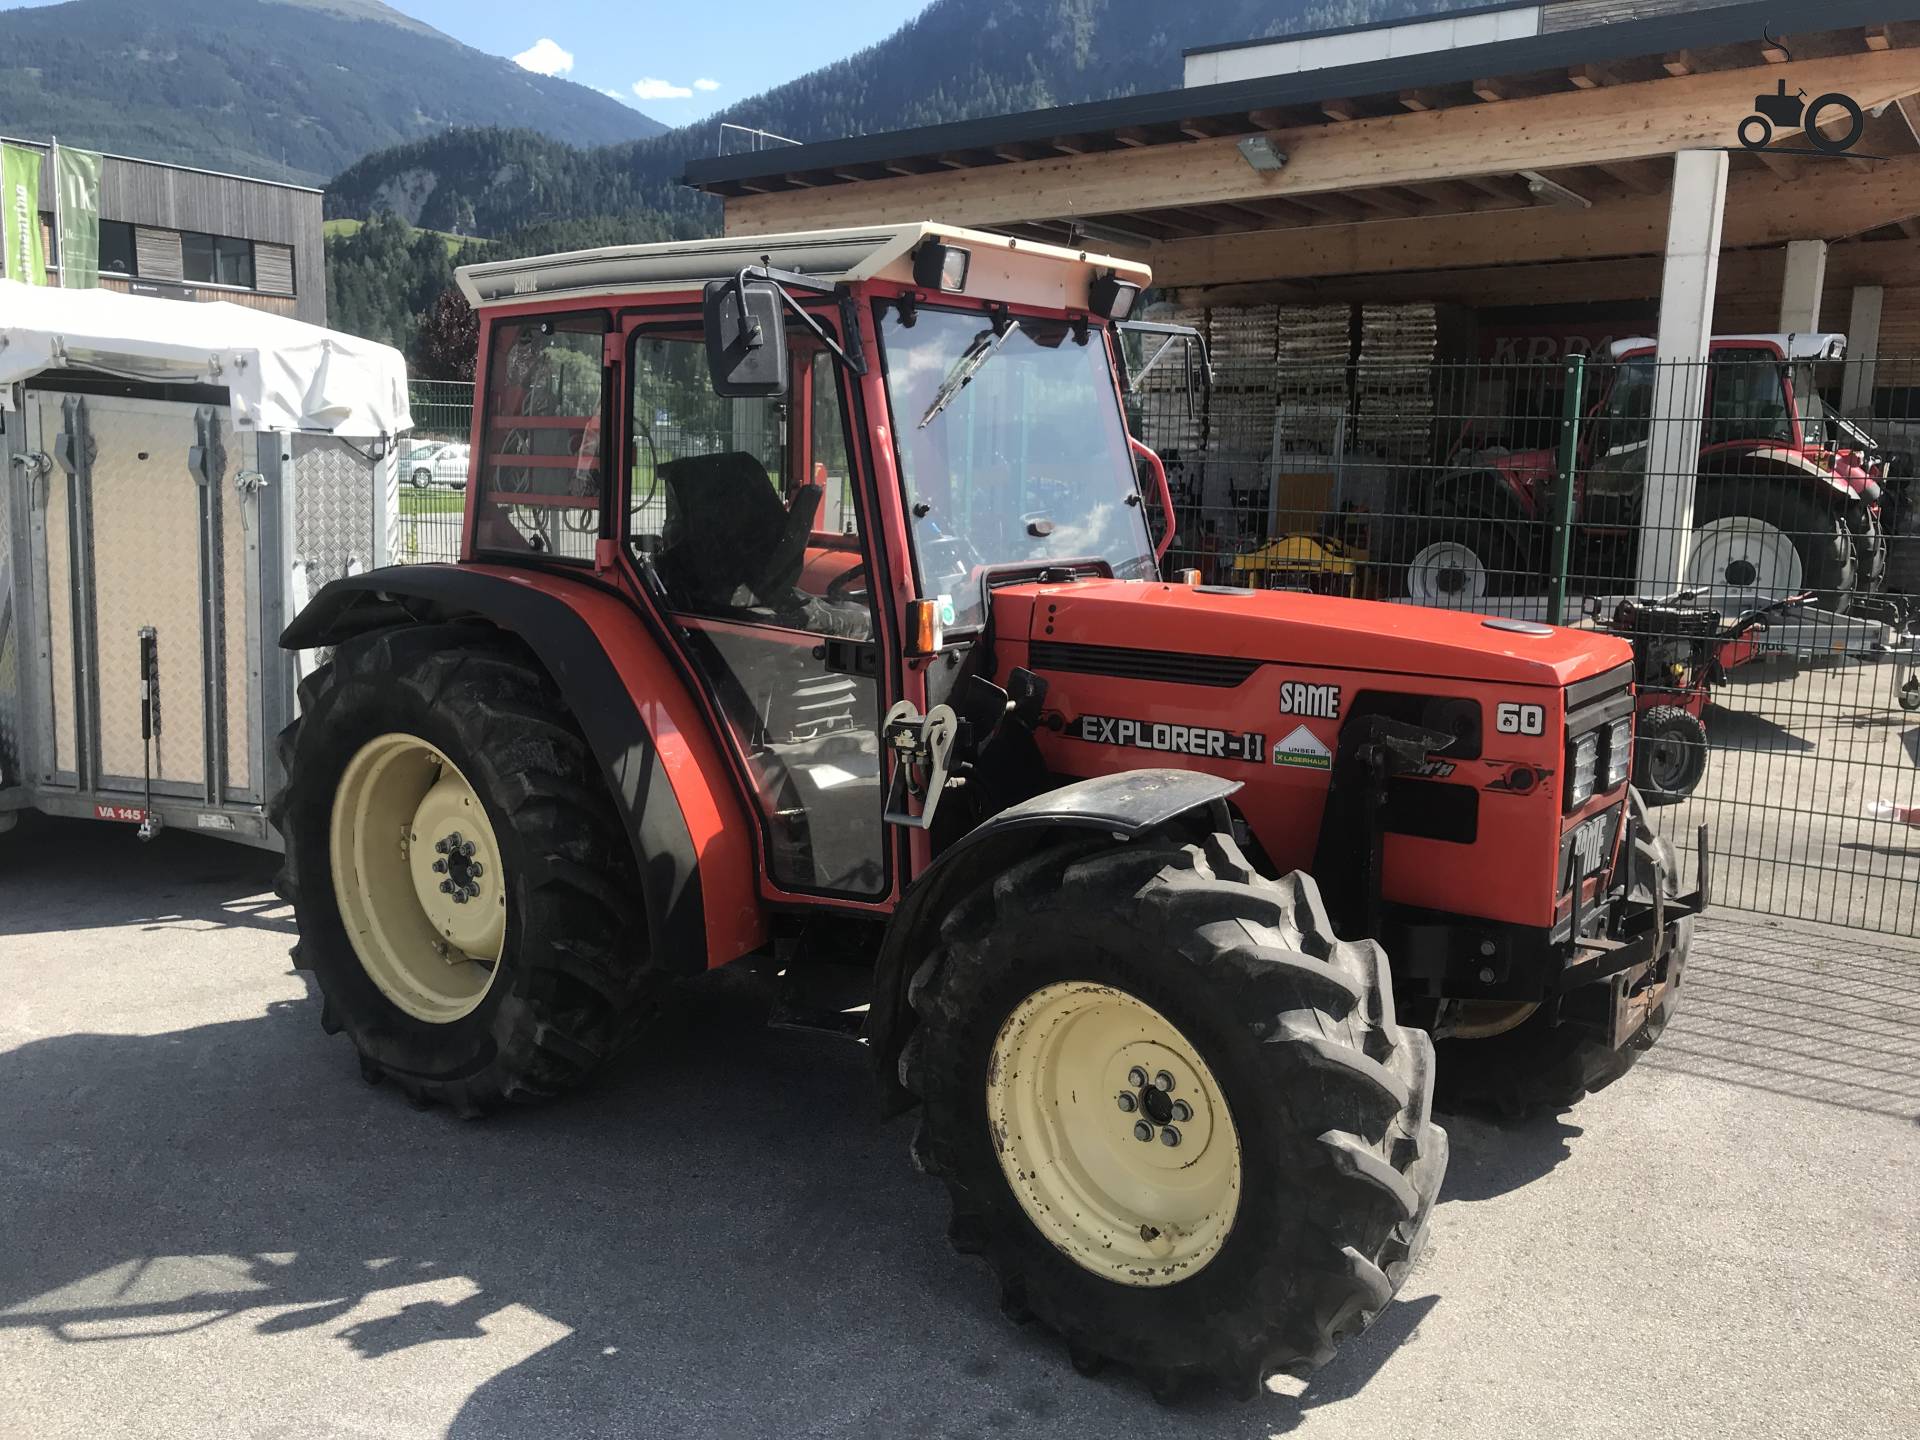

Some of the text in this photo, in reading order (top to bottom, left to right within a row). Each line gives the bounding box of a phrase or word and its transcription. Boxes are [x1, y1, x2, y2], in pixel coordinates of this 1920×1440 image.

[1280, 682, 1340, 718] SAME
[1496, 702, 1543, 735] 60
[1082, 716, 1263, 761] EXPLORER-II
[1283, 756, 1329, 766] LAGERHAUS
[98, 806, 141, 820] VA 145
